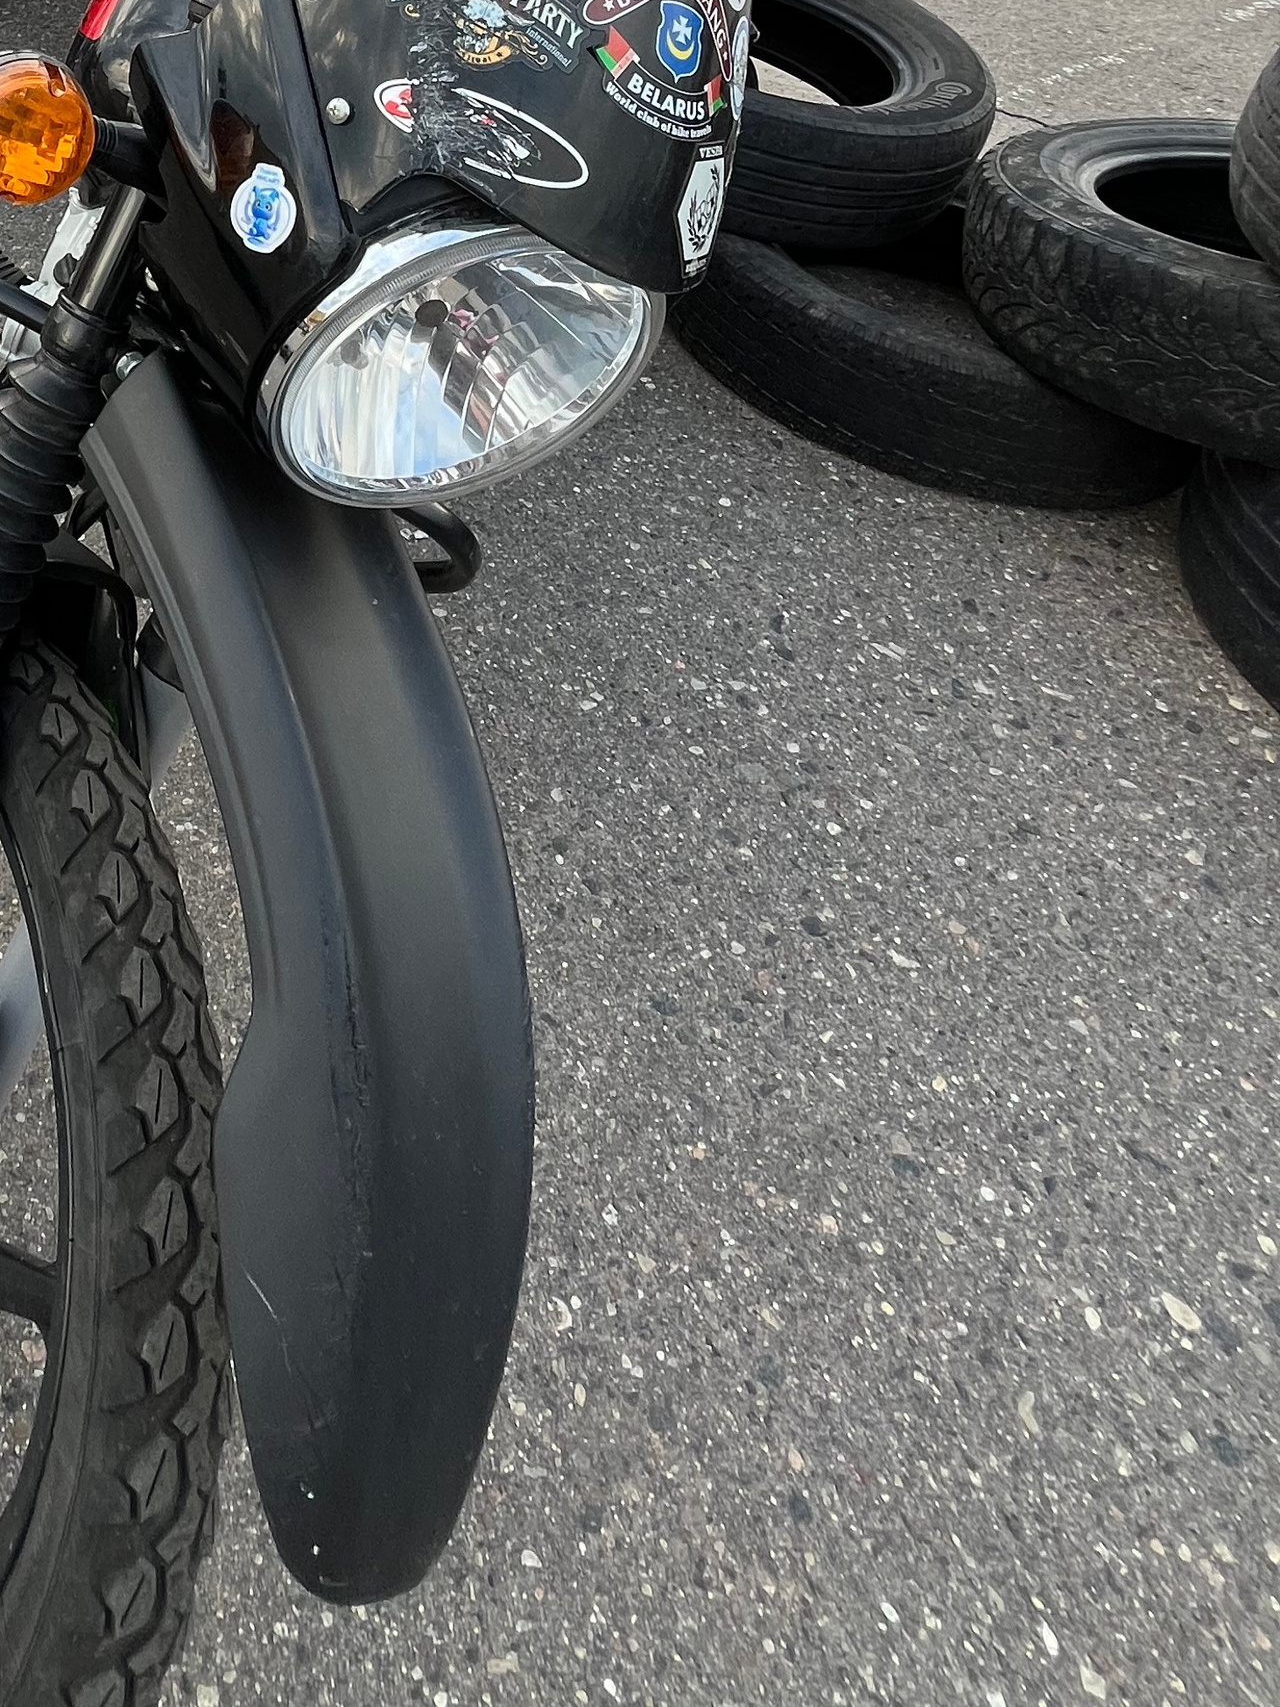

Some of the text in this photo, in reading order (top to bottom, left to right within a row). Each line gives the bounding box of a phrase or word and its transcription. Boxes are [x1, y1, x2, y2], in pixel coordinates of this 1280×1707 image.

[605, 81, 637, 114] World
[636, 109, 660, 128] club
[660, 123, 672, 133] of
[627, 73, 705, 120] BELARUS
